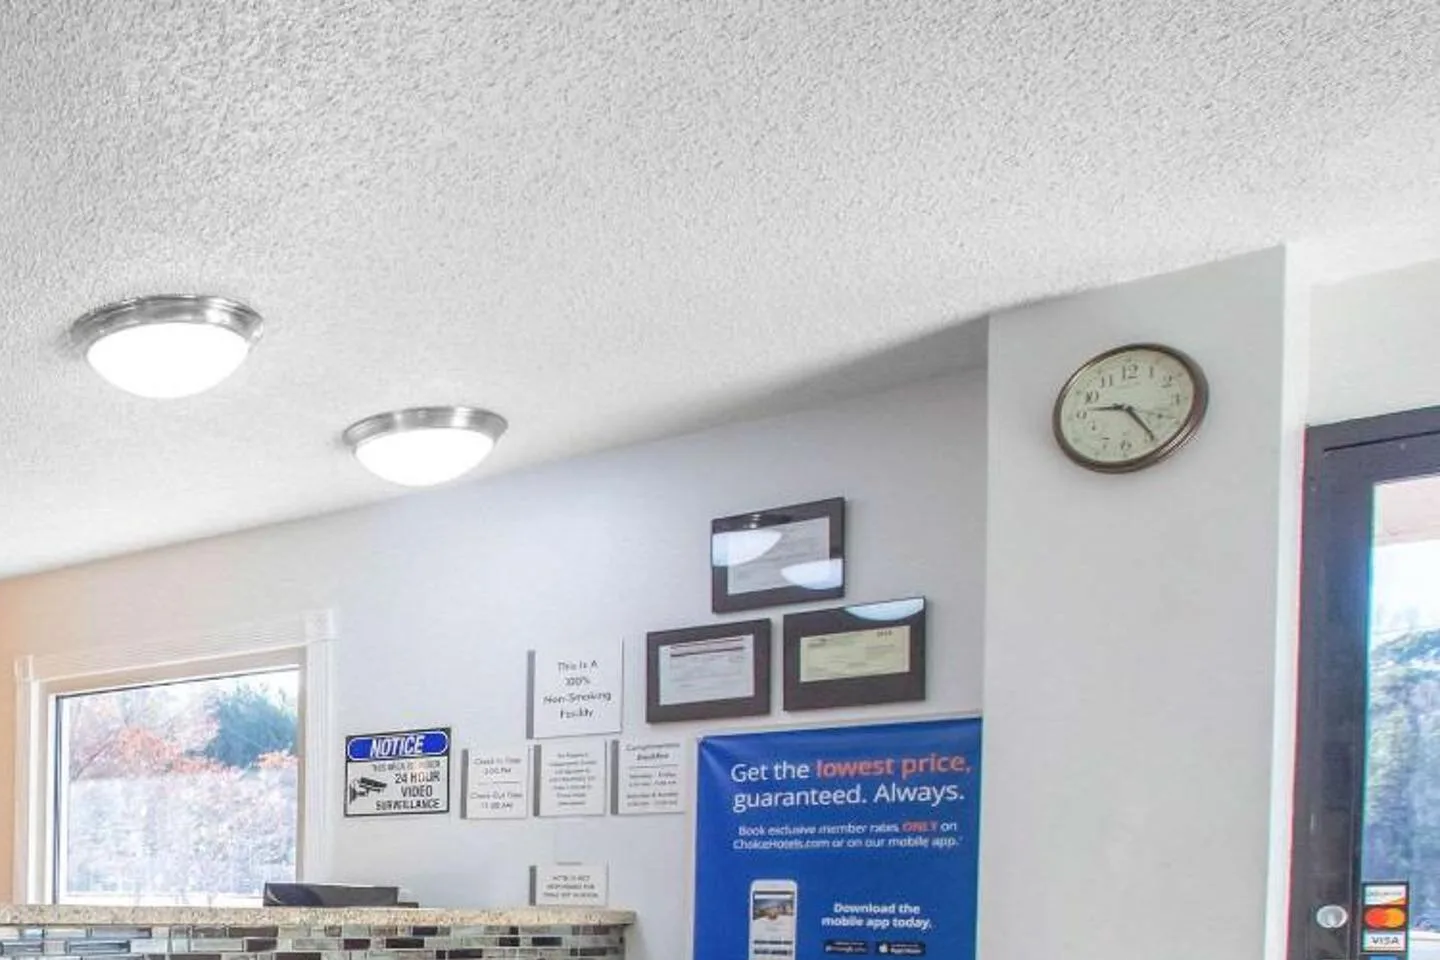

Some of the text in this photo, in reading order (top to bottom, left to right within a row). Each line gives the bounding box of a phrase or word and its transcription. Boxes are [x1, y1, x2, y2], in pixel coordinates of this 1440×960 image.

[591, 659, 600, 669] A
[369, 734, 426, 759] NOTICE
[394, 769, 441, 784] 24 HOUR
[731, 763, 769, 783] Get
[773, 760, 810, 780] the
[816, 757, 895, 779] lowest
[400, 784, 434, 798] VIDEO
[733, 781, 965, 813] guaranteed. Always.
[738, 825, 765, 836] Book
[818, 822, 867, 835] member
[902, 820, 939, 833] ONLY
[940, 821, 958, 832] on
[864, 838, 886, 848] our
[887, 835, 929, 848] mobile
[833, 902, 921, 914] Download the
[821, 916, 865, 927] mobile
[866, 918, 891, 930] app
[1370, 936, 1400, 945] VISA
